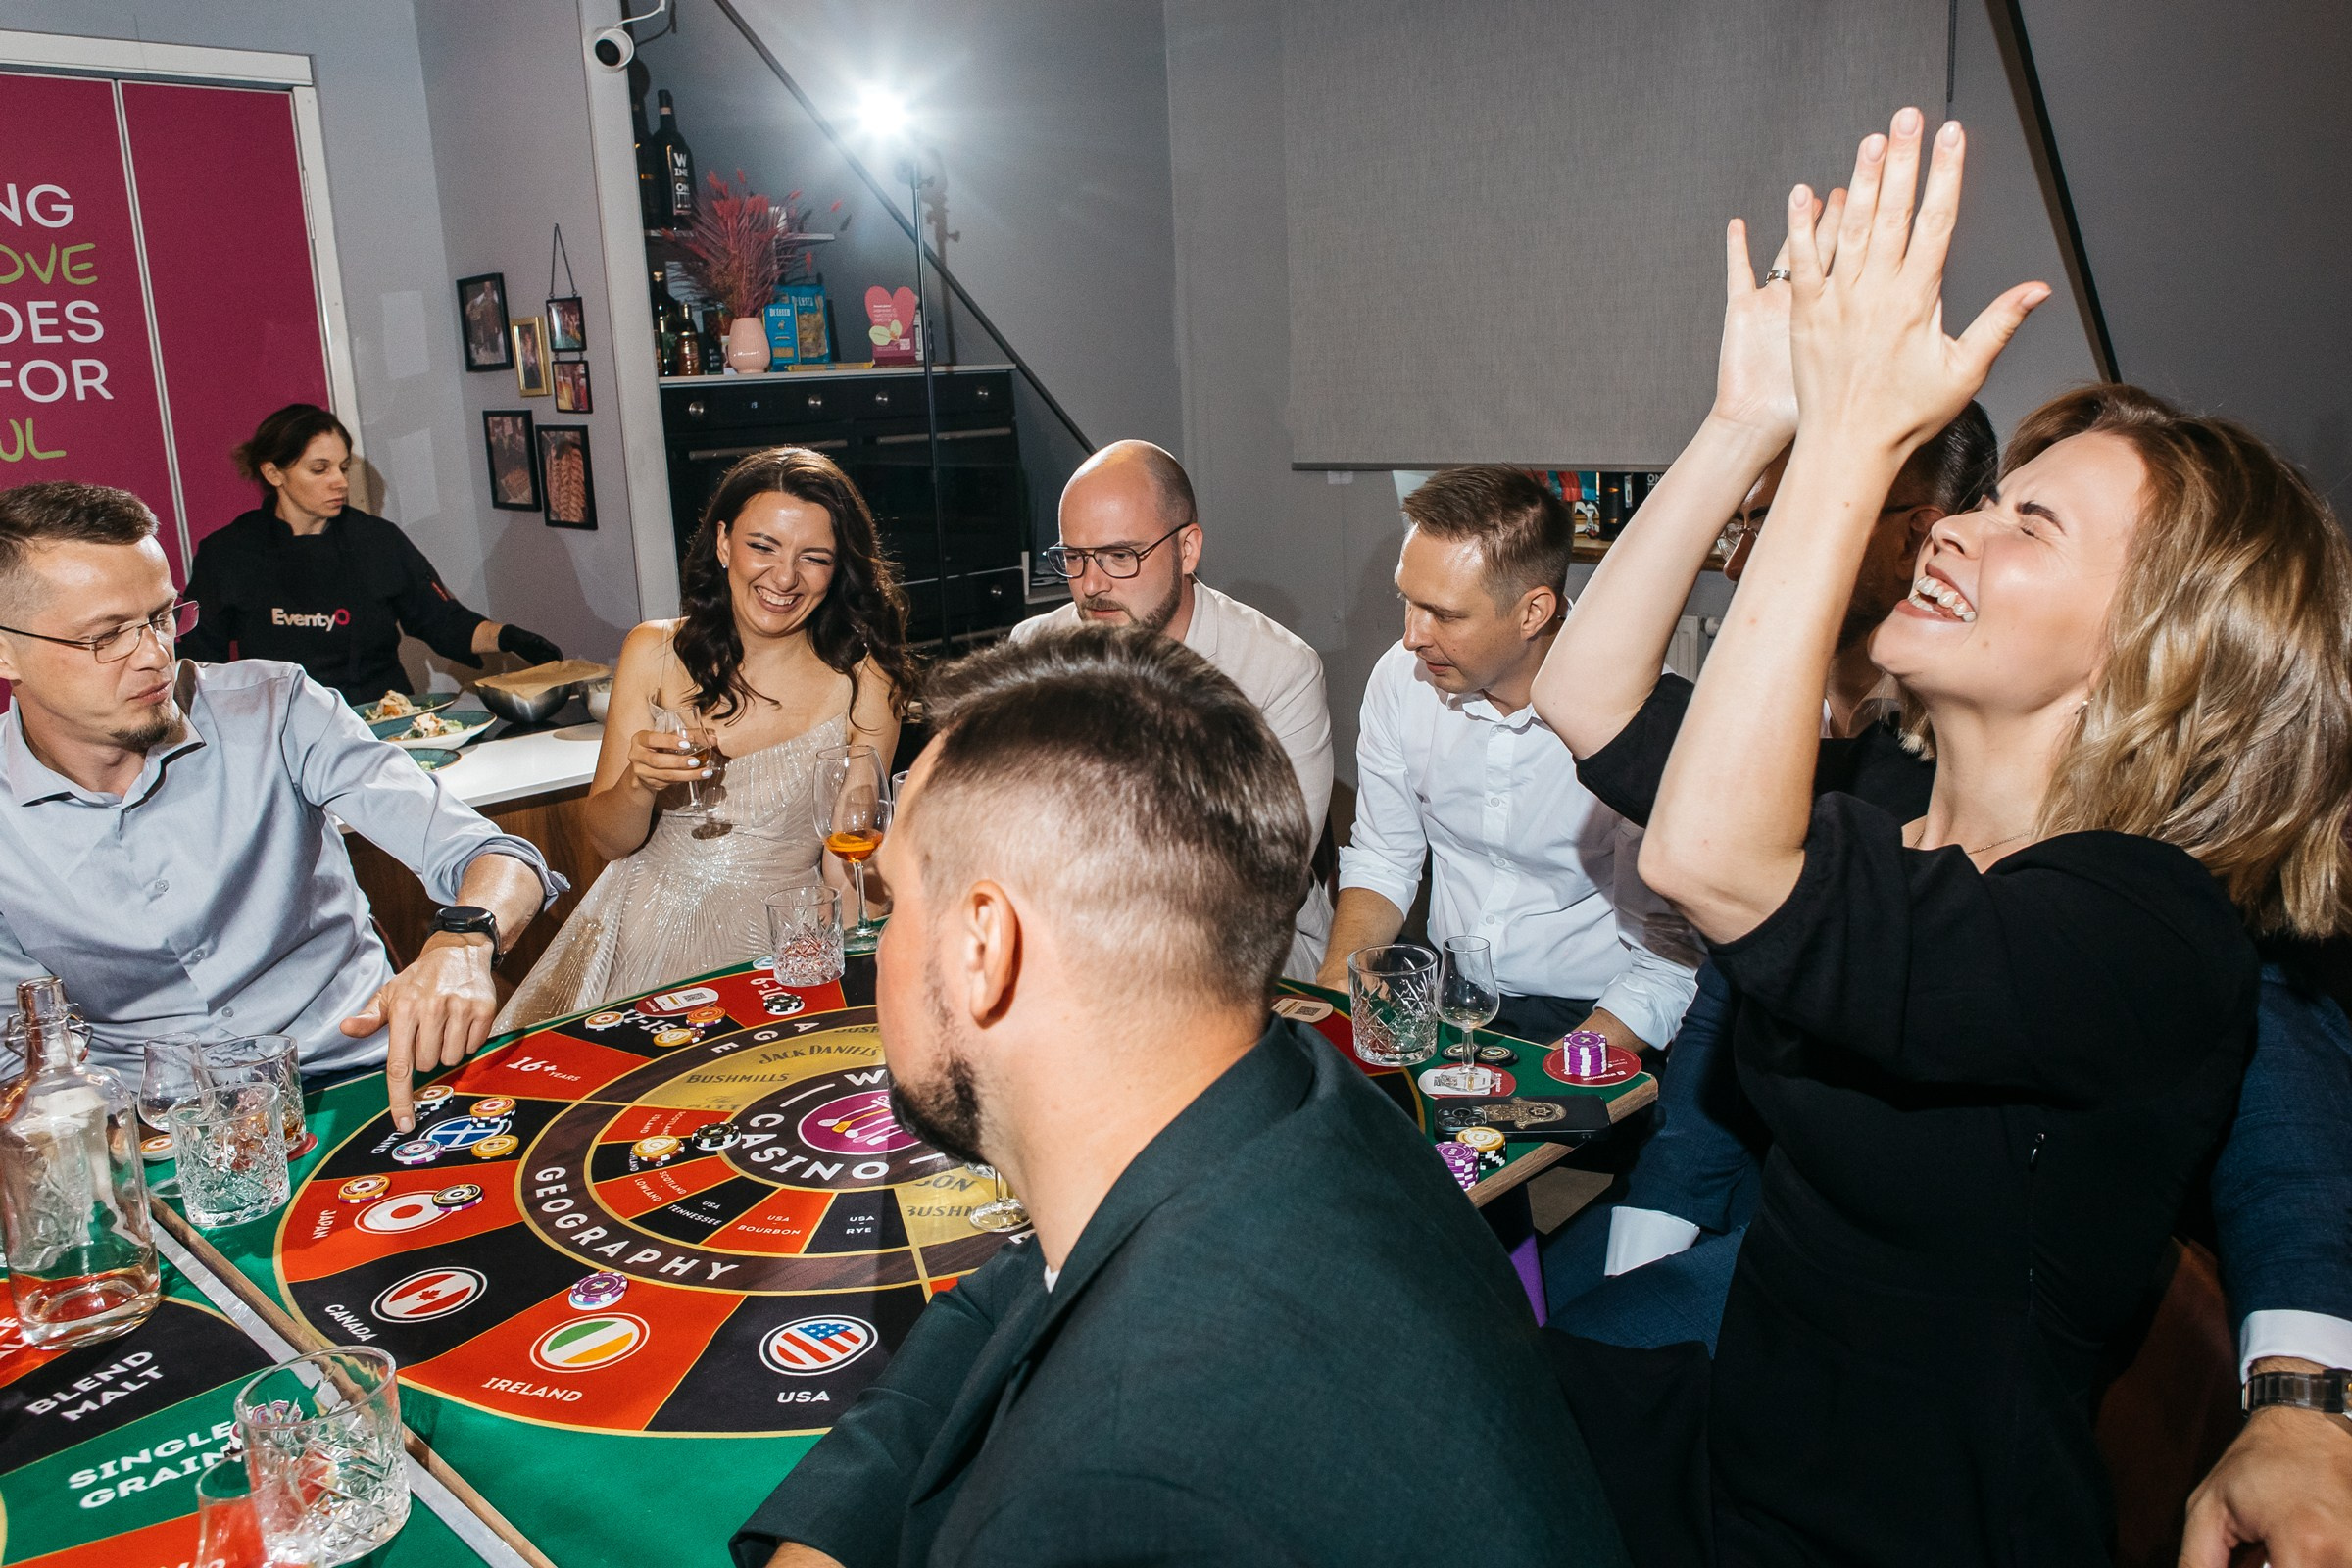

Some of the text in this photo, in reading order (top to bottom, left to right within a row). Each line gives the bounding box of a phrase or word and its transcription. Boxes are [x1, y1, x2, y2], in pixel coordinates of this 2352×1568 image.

[506, 1056, 582, 1082] 16+ YEARS
[687, 1072, 790, 1084] BUSHMILLS
[661, 1111, 686, 1136] SCOTLAN
[742, 1113, 890, 1181] CASINO
[634, 1178, 662, 1202] LOWLAND
[659, 1170, 687, 1195] SCOTLAND
[667, 1203, 723, 1226] TENNESSEE
[702, 1200, 721, 1211] USA
[312, 1209, 337, 1240] JAPAN
[534, 1166, 740, 1282] GEOGRAPHY
[737, 1224, 801, 1236] BOURBON
[846, 1226, 872, 1235] RYE
[324, 1304, 378, 1342] CANADA
[24, 1351, 153, 1415] BLEND
[61, 1365, 164, 1421] MALT
[480, 1377, 583, 1403] IRELAND
[776, 1390, 831, 1404] USA
[68, 1420, 232, 1490] SINGLE
